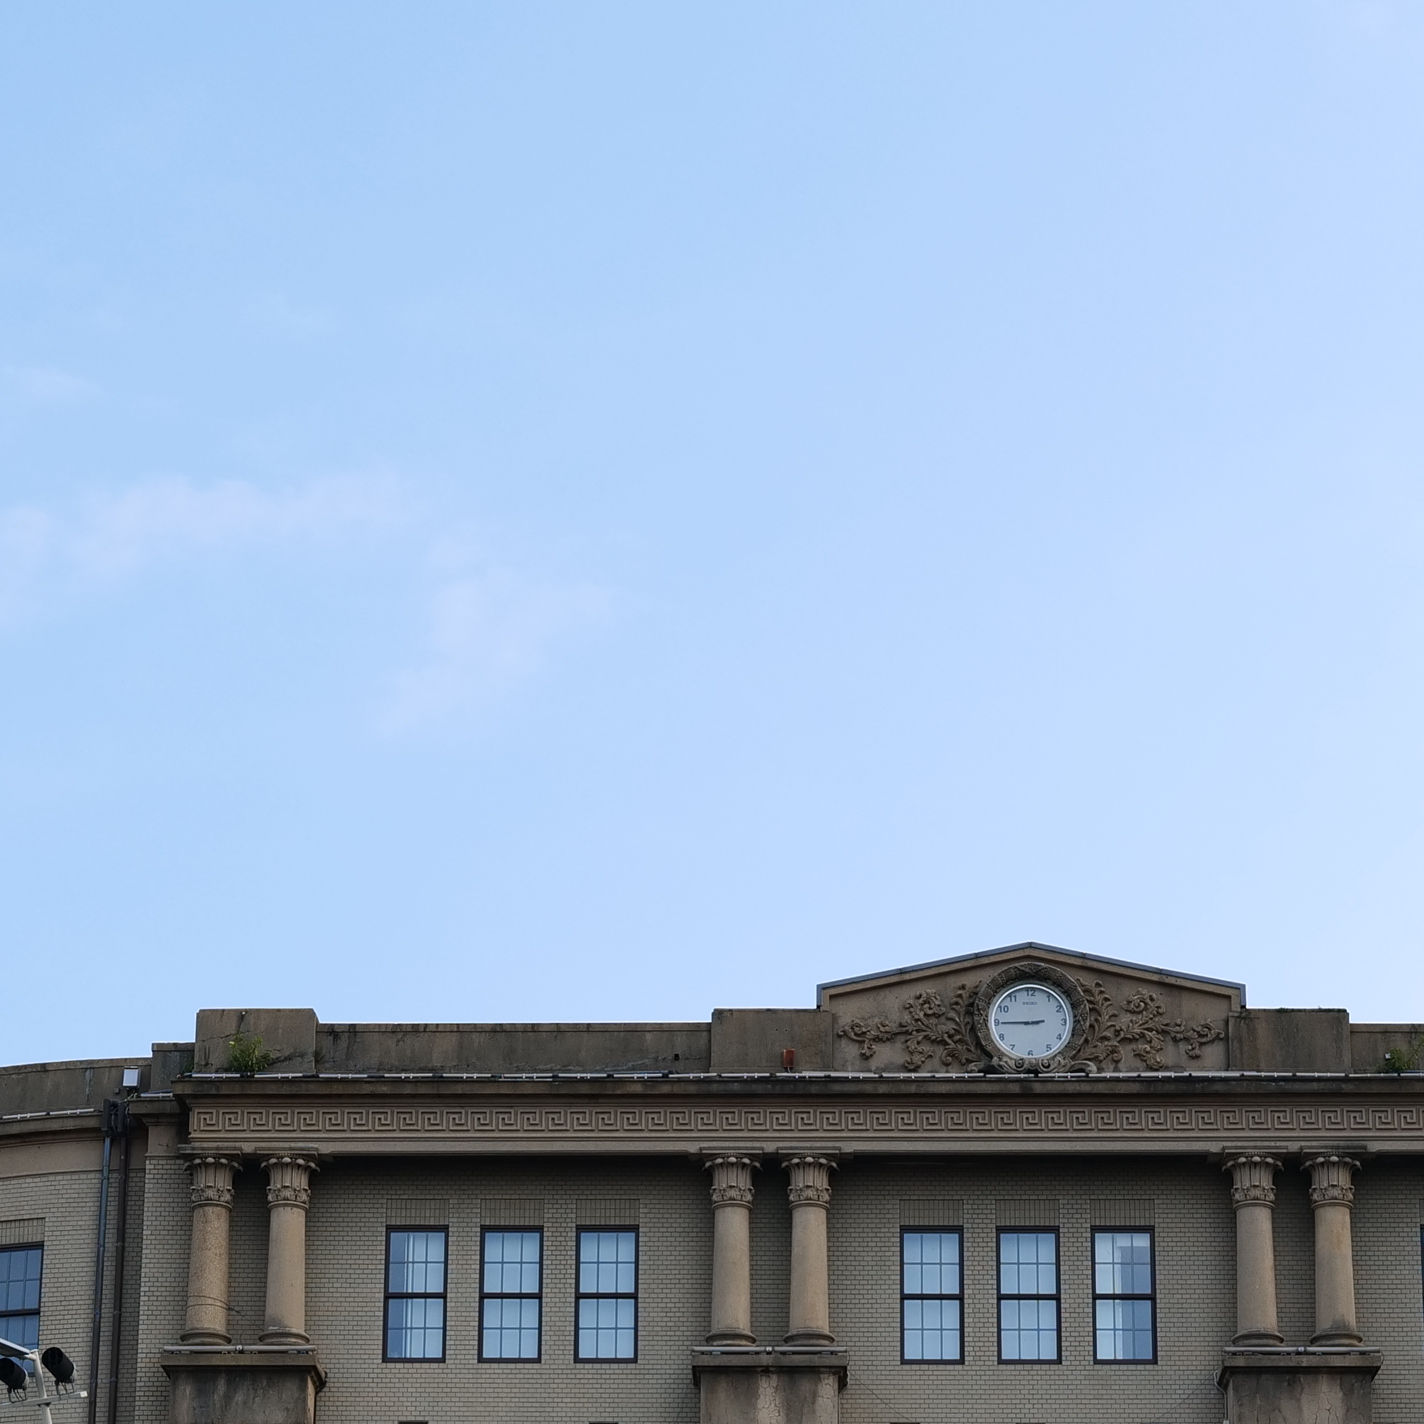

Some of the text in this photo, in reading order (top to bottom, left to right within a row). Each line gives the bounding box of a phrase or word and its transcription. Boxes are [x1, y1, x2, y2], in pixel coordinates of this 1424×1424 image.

[1025, 989, 1036, 997] 12
[1009, 994, 1017, 1002] 11
[998, 1005, 1009, 1013] 10
[1056, 1005, 1062, 1013] 2
[1061, 1018, 1067, 1026] 3
[999, 1033, 1005, 1041] 8
[1056, 1033, 1062, 1041] 4
[1046, 1044, 1052, 1052] 5
